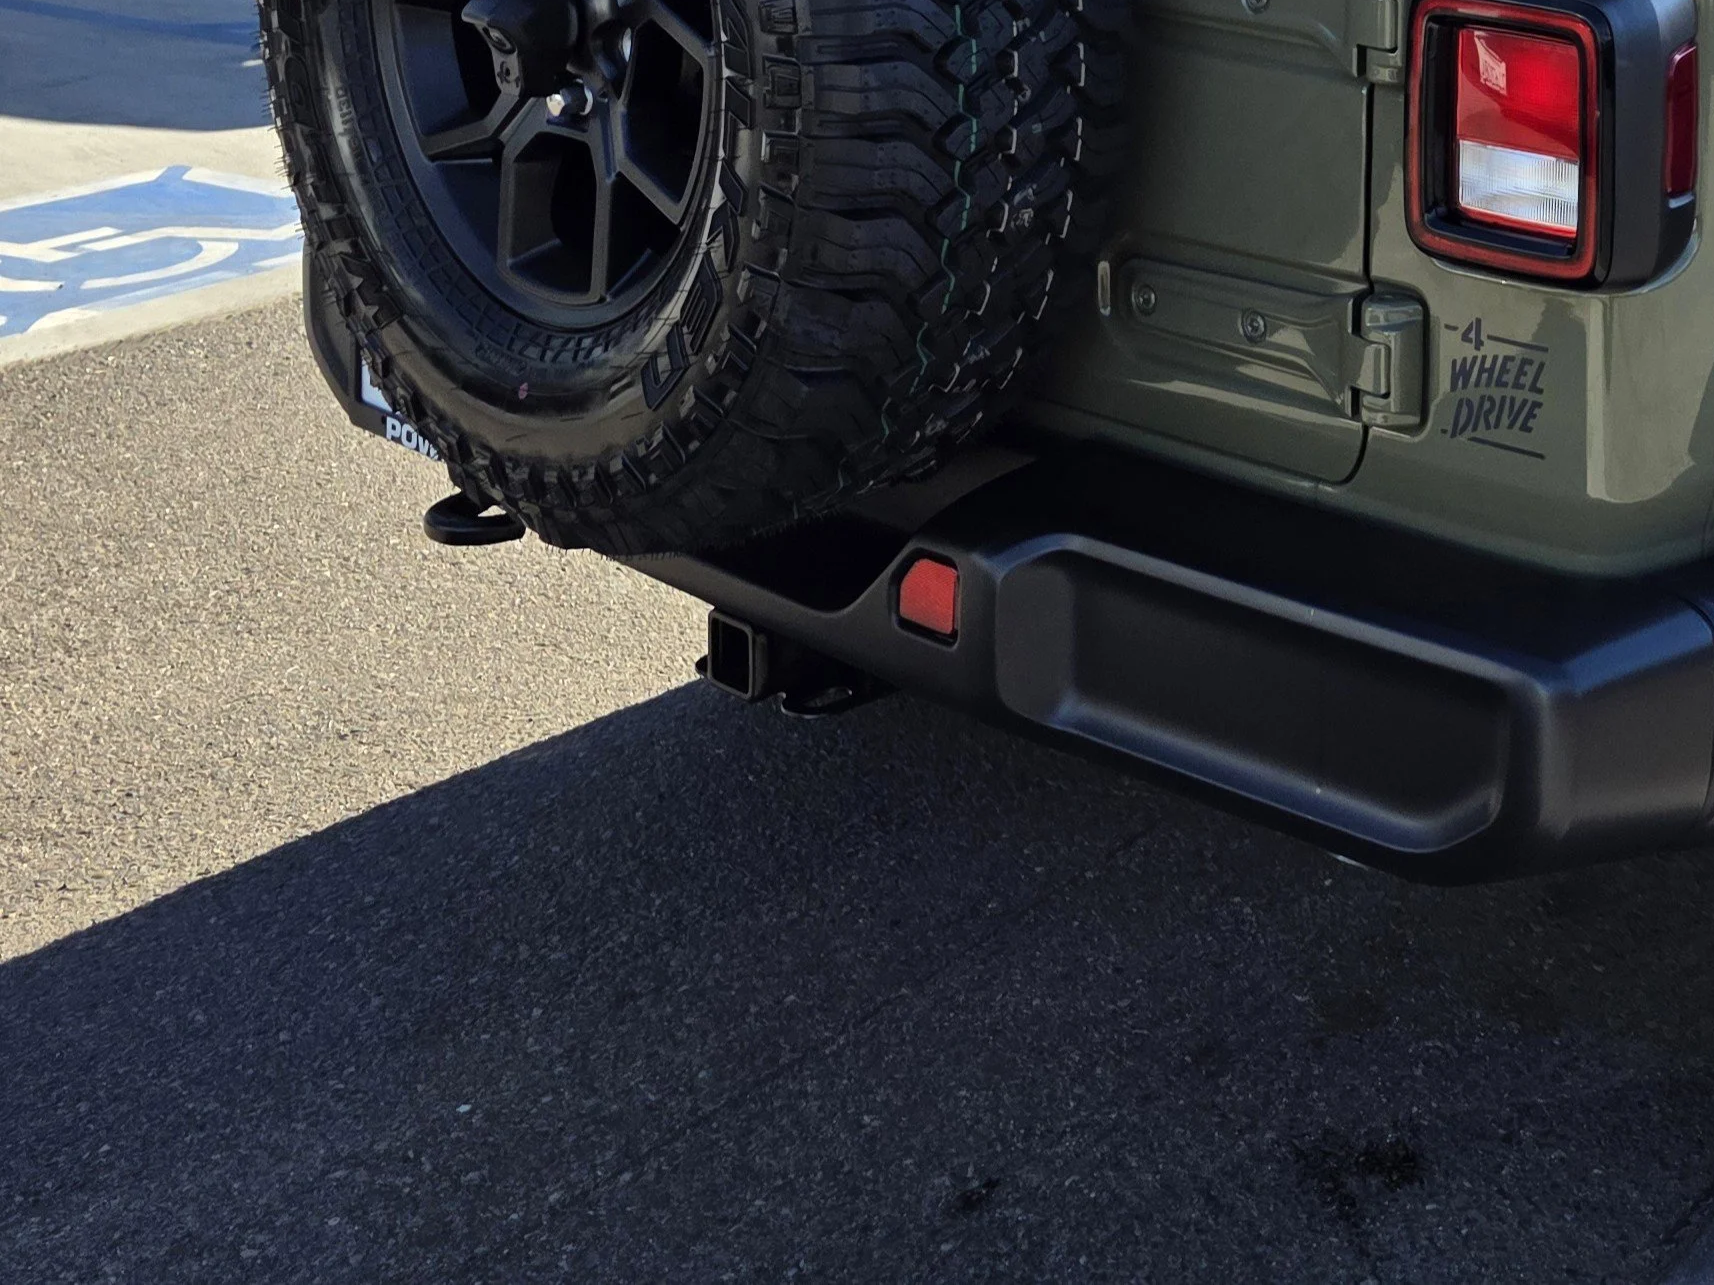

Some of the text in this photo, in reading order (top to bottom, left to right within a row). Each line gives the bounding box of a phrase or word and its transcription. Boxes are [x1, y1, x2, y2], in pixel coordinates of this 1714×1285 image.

[1461, 317, 1485, 351] 4
[1450, 354, 1546, 395] WHEEL
[1450, 394, 1544, 439] DRIVE
